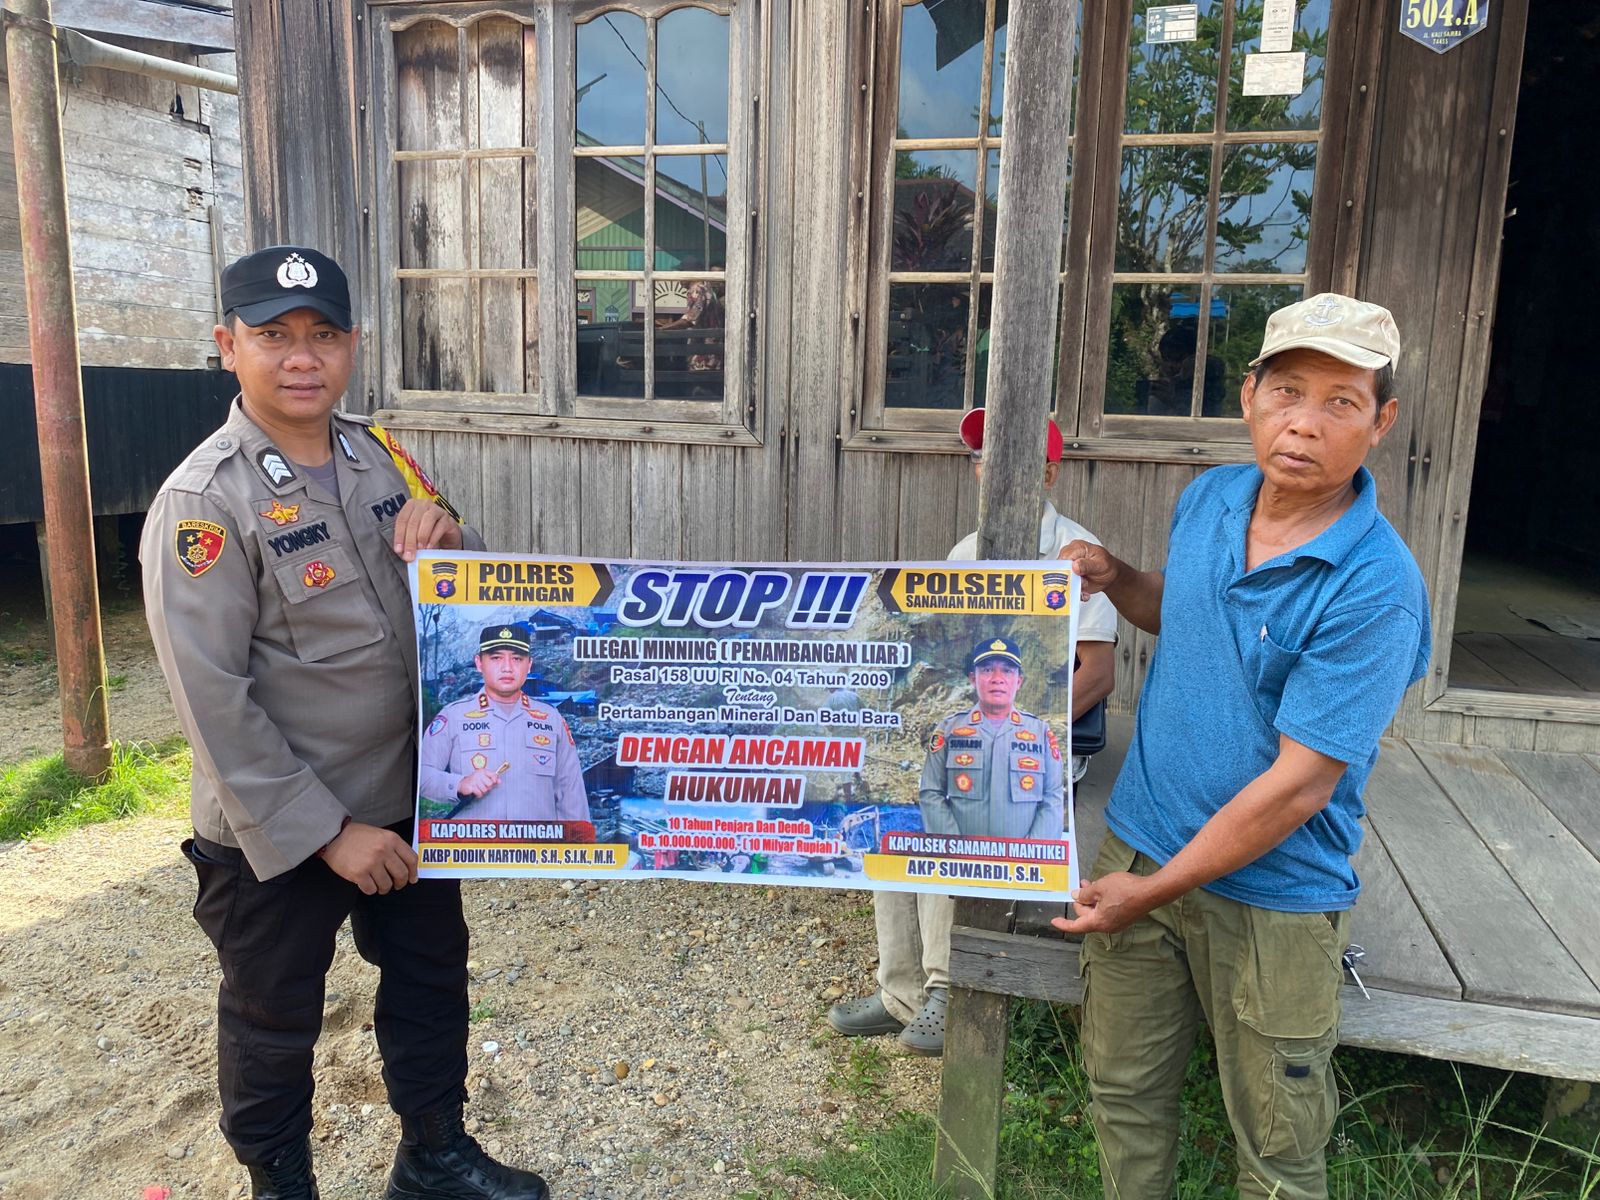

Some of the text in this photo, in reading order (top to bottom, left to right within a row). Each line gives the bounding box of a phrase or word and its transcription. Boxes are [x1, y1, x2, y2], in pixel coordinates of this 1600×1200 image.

[1406, 0, 1478, 28] 504.A
[268, 520, 331, 558] YONGKY
[479, 562, 574, 585] POLRES
[905, 572, 1026, 596] POLSEK
[478, 586, 575, 603] KATINGAN
[621, 571, 869, 625] STOP !!!
[905, 595, 1026, 610] SANAMAN MANTIKEI
[576, 638, 640, 660] ILLEGAL
[643, 639, 717, 661] MINNING
[731, 642, 858, 664] PENAMBANGAN
[860, 644, 901, 665] LIAR
[612, 667, 889, 687] Pasal 158 UU RI No. 04 Tahun 2009
[724, 687, 775, 706] Tentang
[600, 706, 899, 725] Pertambangan Mineral Dan Batu Bara
[462, 722, 490, 731] DODIK
[527, 721, 553, 732] POLRI
[620, 736, 862, 768] DENGAN ANCAMAN
[1011, 741, 1042, 753] POLRI
[668, 775, 802, 805] HUKUMAN
[431, 823, 564, 839] KAPOLRES KATINGAN
[668, 817, 811, 835] 10 Tahun Penjara Dan Denda
[641, 834, 656, 848] Rp.
[749, 838, 760, 851] 10
[762, 839, 795, 852] Milyar
[796, 840, 832, 854] Rupiah
[888, 835, 1066, 860] KAPOLSEK SANAMAN MANTIKEI
[422, 848, 616, 865] AKBP DODIK HARTONO, S.H., S.I.K., M.H.
[907, 859, 1044, 882] AKP SUWARDI, S.H.
